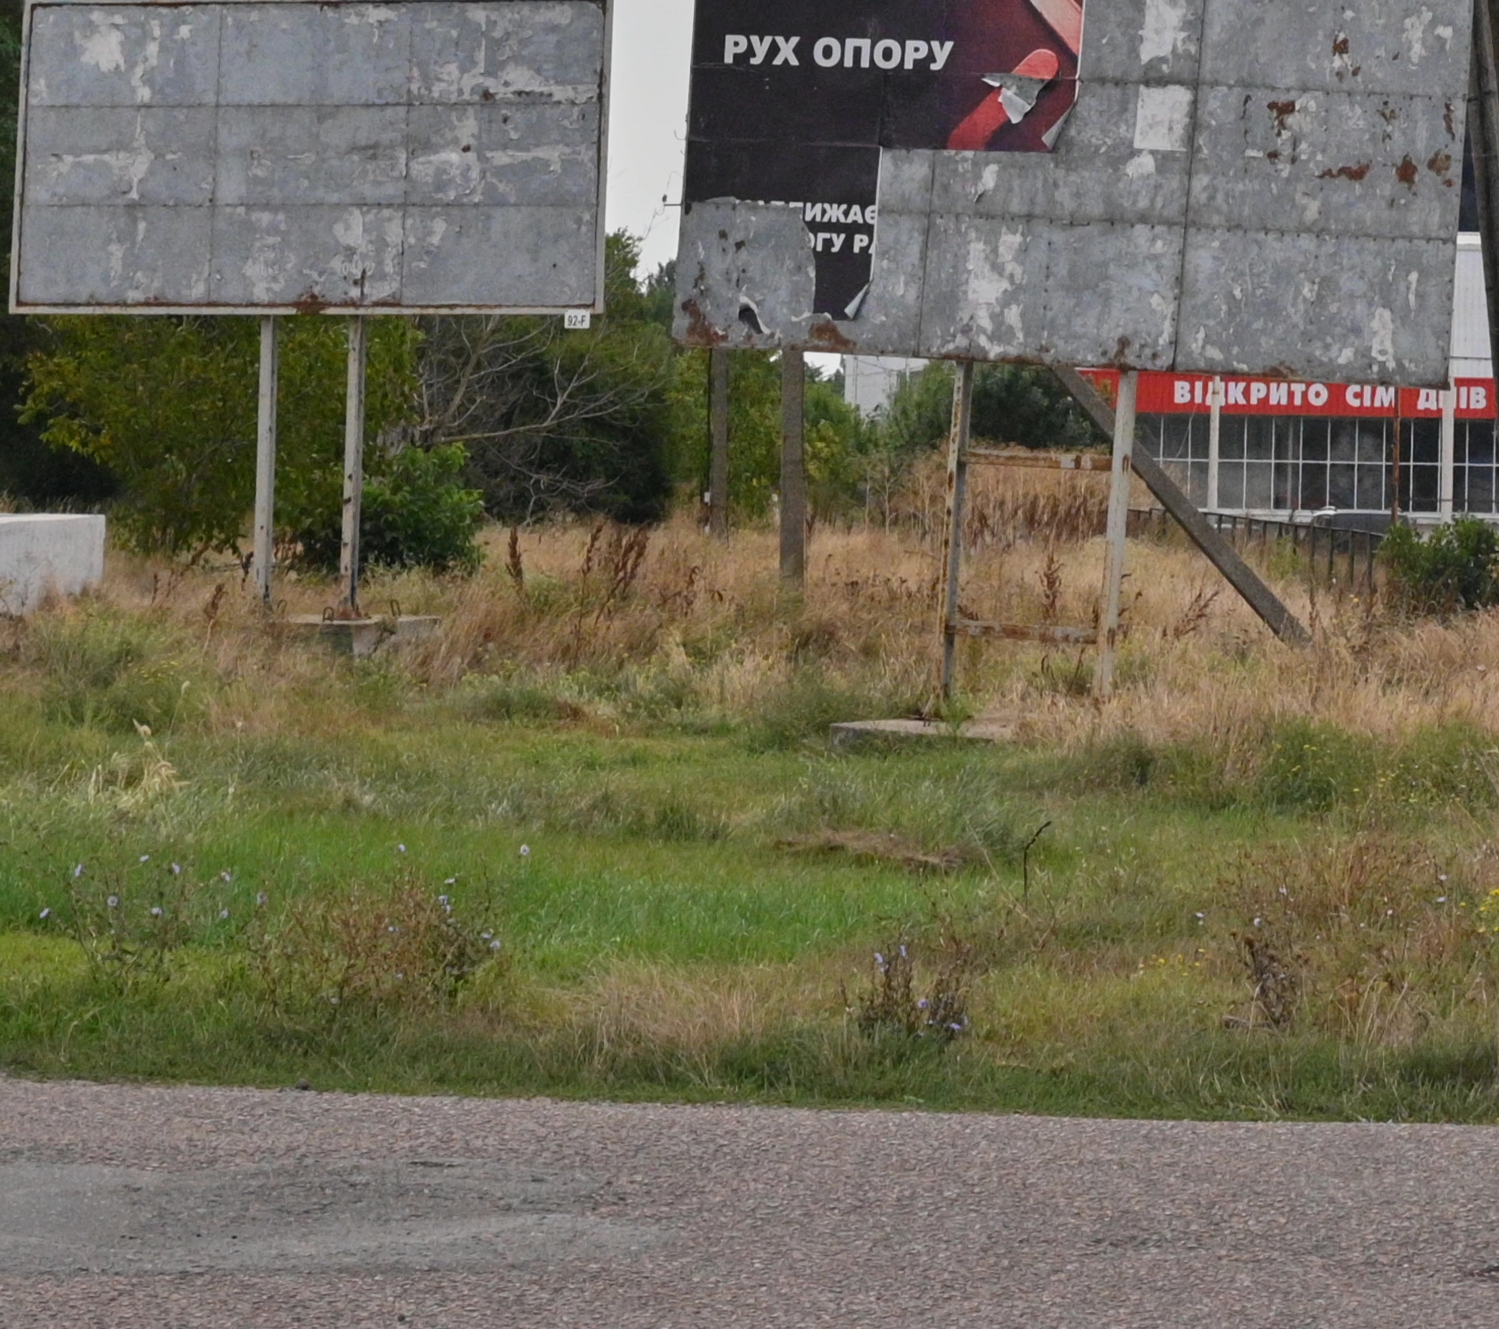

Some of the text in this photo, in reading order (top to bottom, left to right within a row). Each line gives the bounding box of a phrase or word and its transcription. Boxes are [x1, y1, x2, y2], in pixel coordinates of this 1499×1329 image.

[723, 34, 955, 71] РУХ ОПОРУ
[1345, 384, 1396, 408] СІМ
